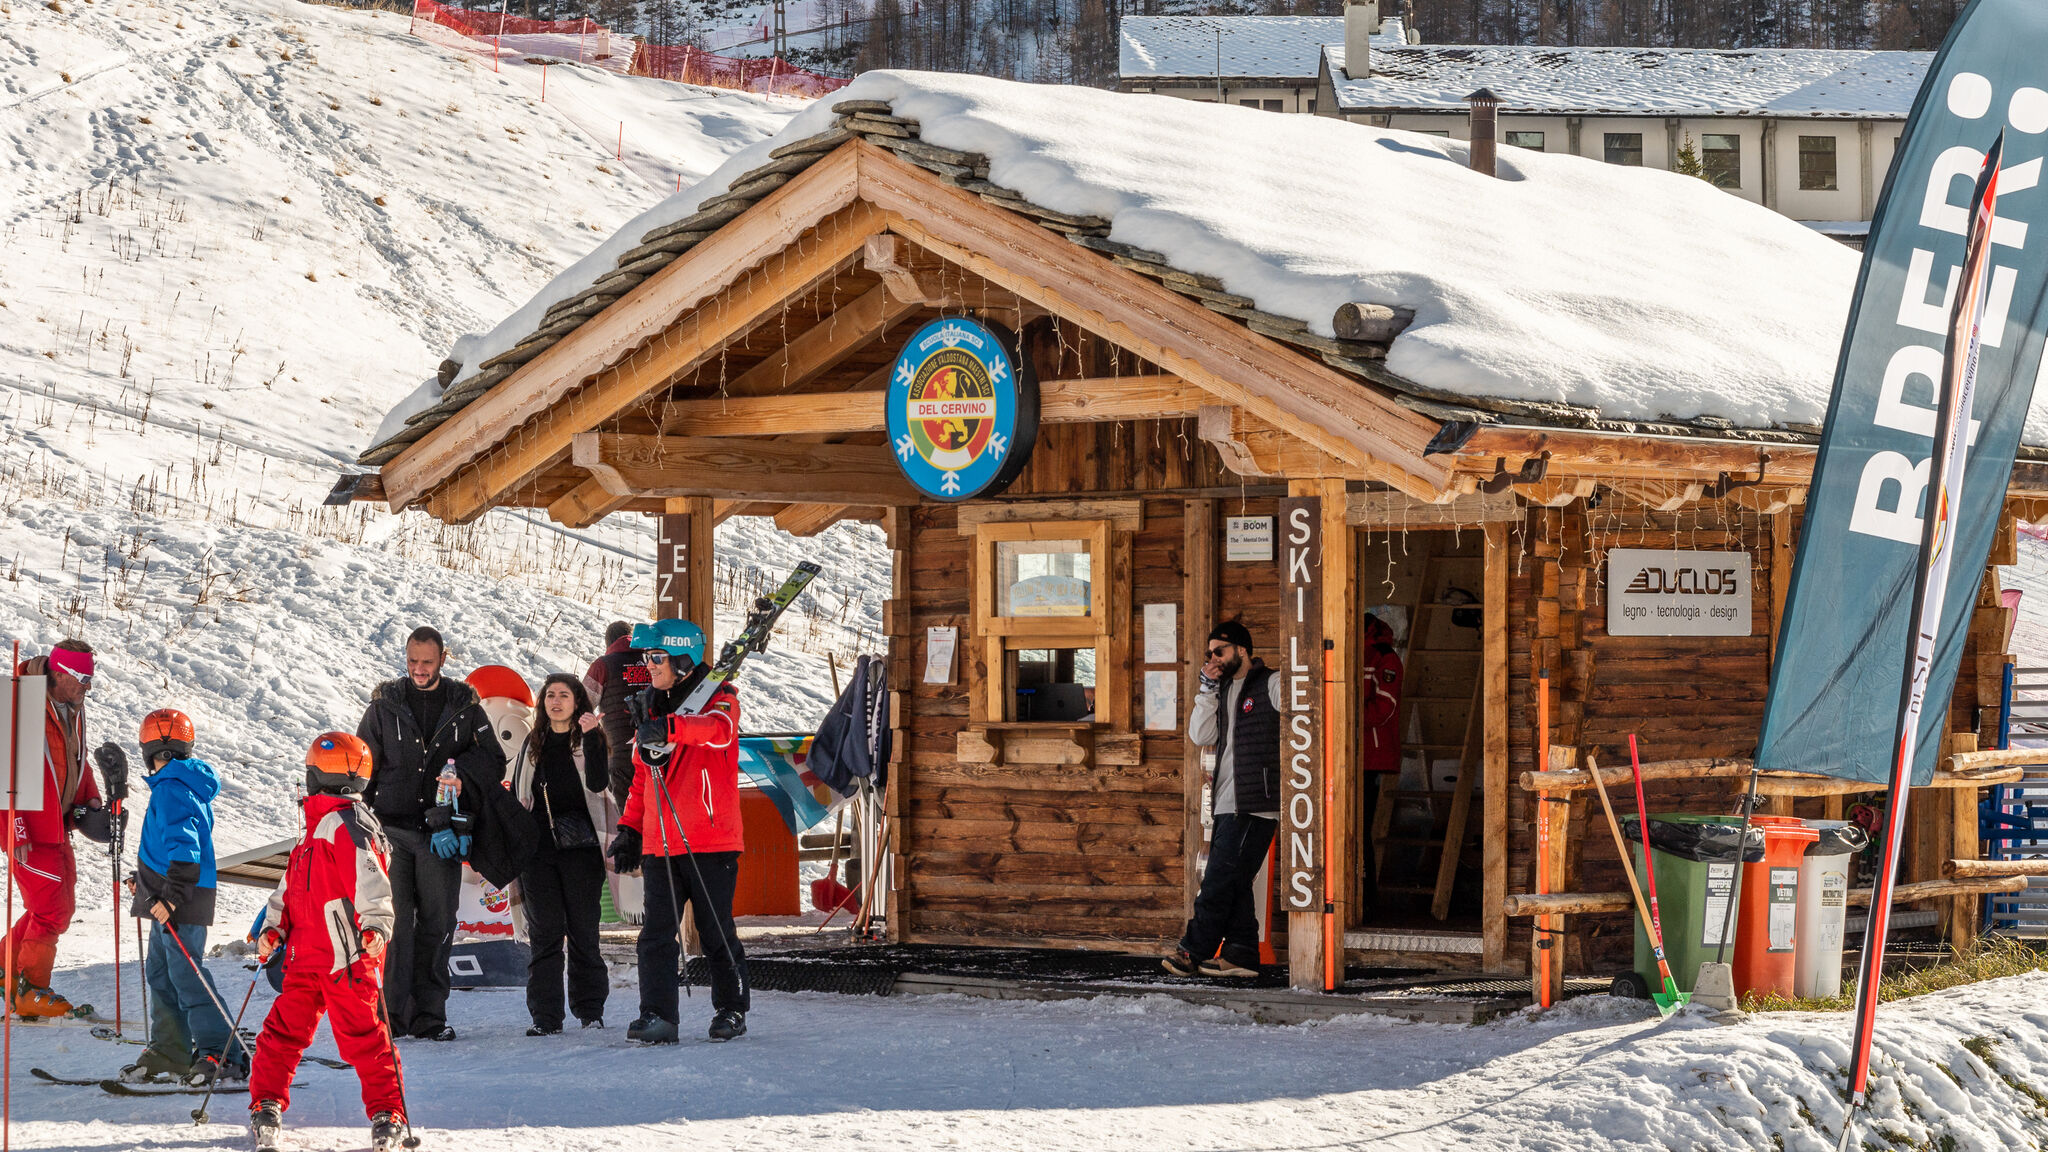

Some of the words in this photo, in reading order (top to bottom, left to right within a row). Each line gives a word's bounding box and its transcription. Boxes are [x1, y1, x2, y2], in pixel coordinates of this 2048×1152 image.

[922, 332, 944, 349] SCUOLA
[944, 331, 970, 341] ITALIANA
[971, 336, 981, 347] SCI
[911, 358, 940, 398] ASSOCIAZIONE
[938, 352, 969, 366] VALDOSTANA
[968, 358, 986, 387] MAESTRI
[980, 383, 990, 396] SCI
[918, 404, 938, 415] DEL
[941, 402, 986, 415] CERVINO
[1243, 522, 1267, 530] BOOM
[1288, 508, 1312, 623] SKI
[1624, 567, 1737, 595] DUCLOS
[1622, 603, 1647, 621] legno
[1657, 604, 1701, 621] tecnologia
[1710, 604, 1738, 621] design
[1289, 636, 1313, 908] LESSONS
[14, 816, 27, 840] EA7
